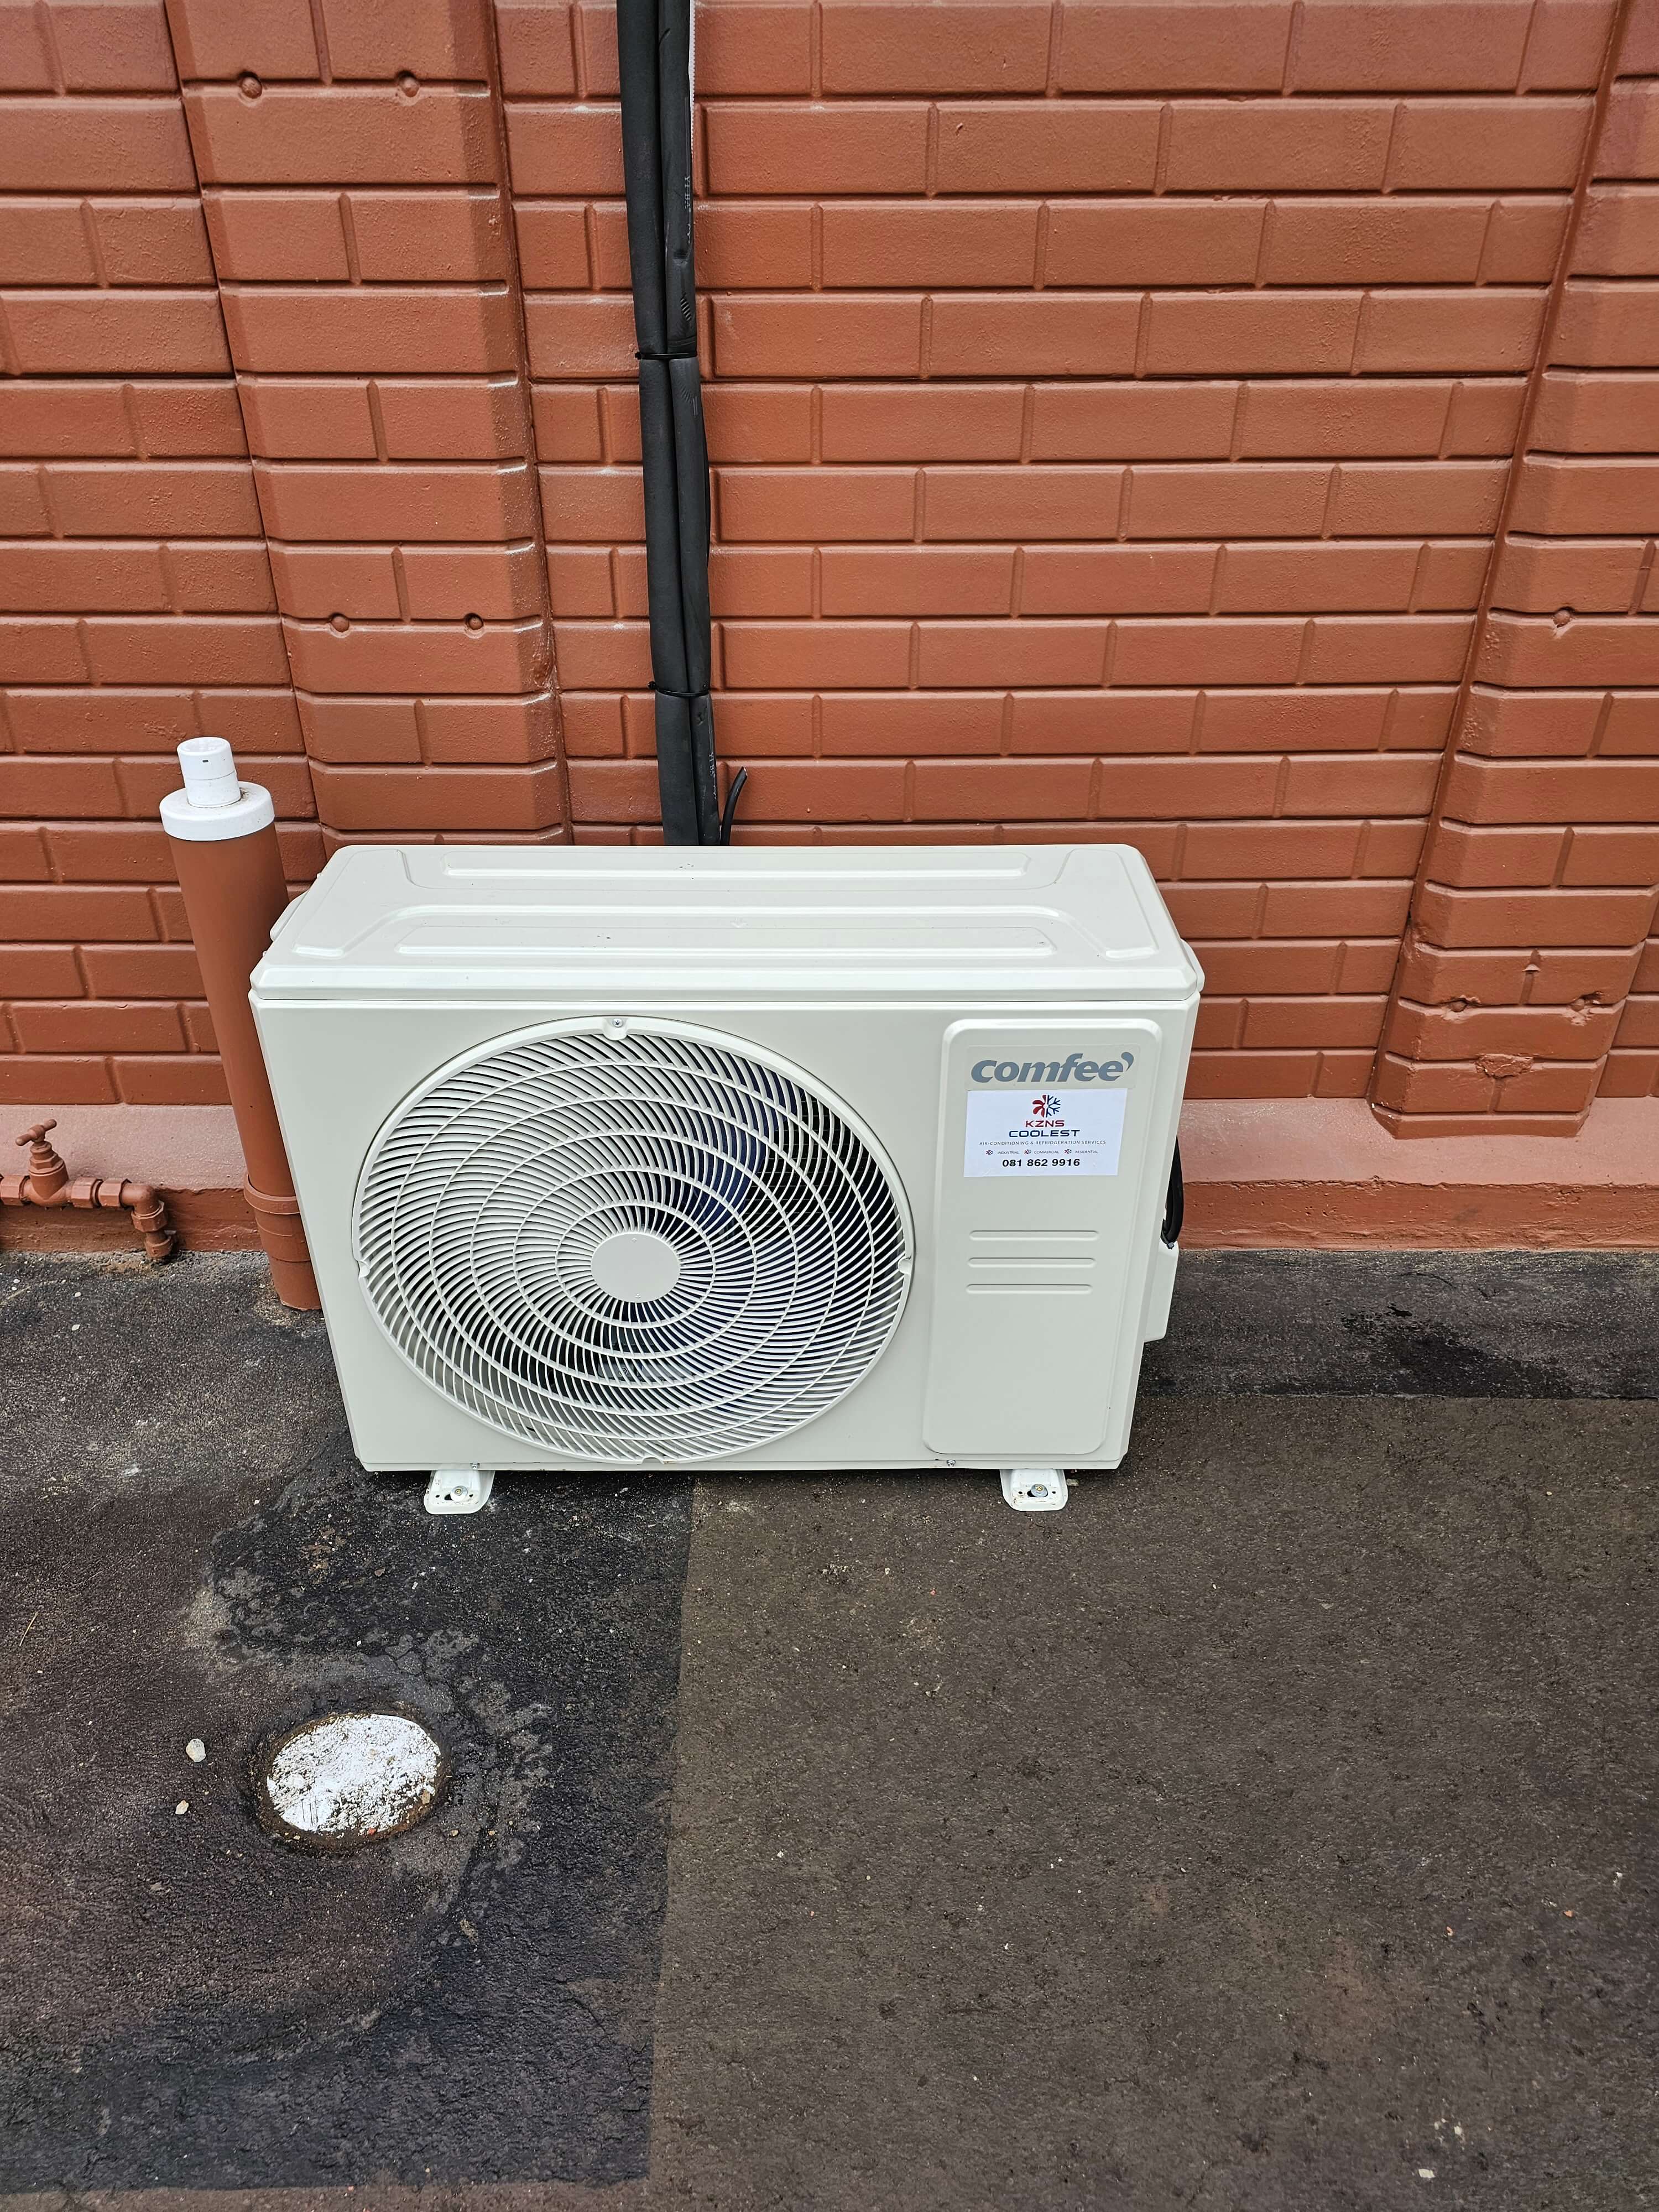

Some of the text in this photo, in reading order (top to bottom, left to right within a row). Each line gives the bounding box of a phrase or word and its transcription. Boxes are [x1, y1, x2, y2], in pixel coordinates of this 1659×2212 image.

[1025, 1120, 1065, 1128] KZNS
[1009, 1129, 1081, 1138] COOLEST
[1002, 1158, 1081, 1167] 081 862 9916
